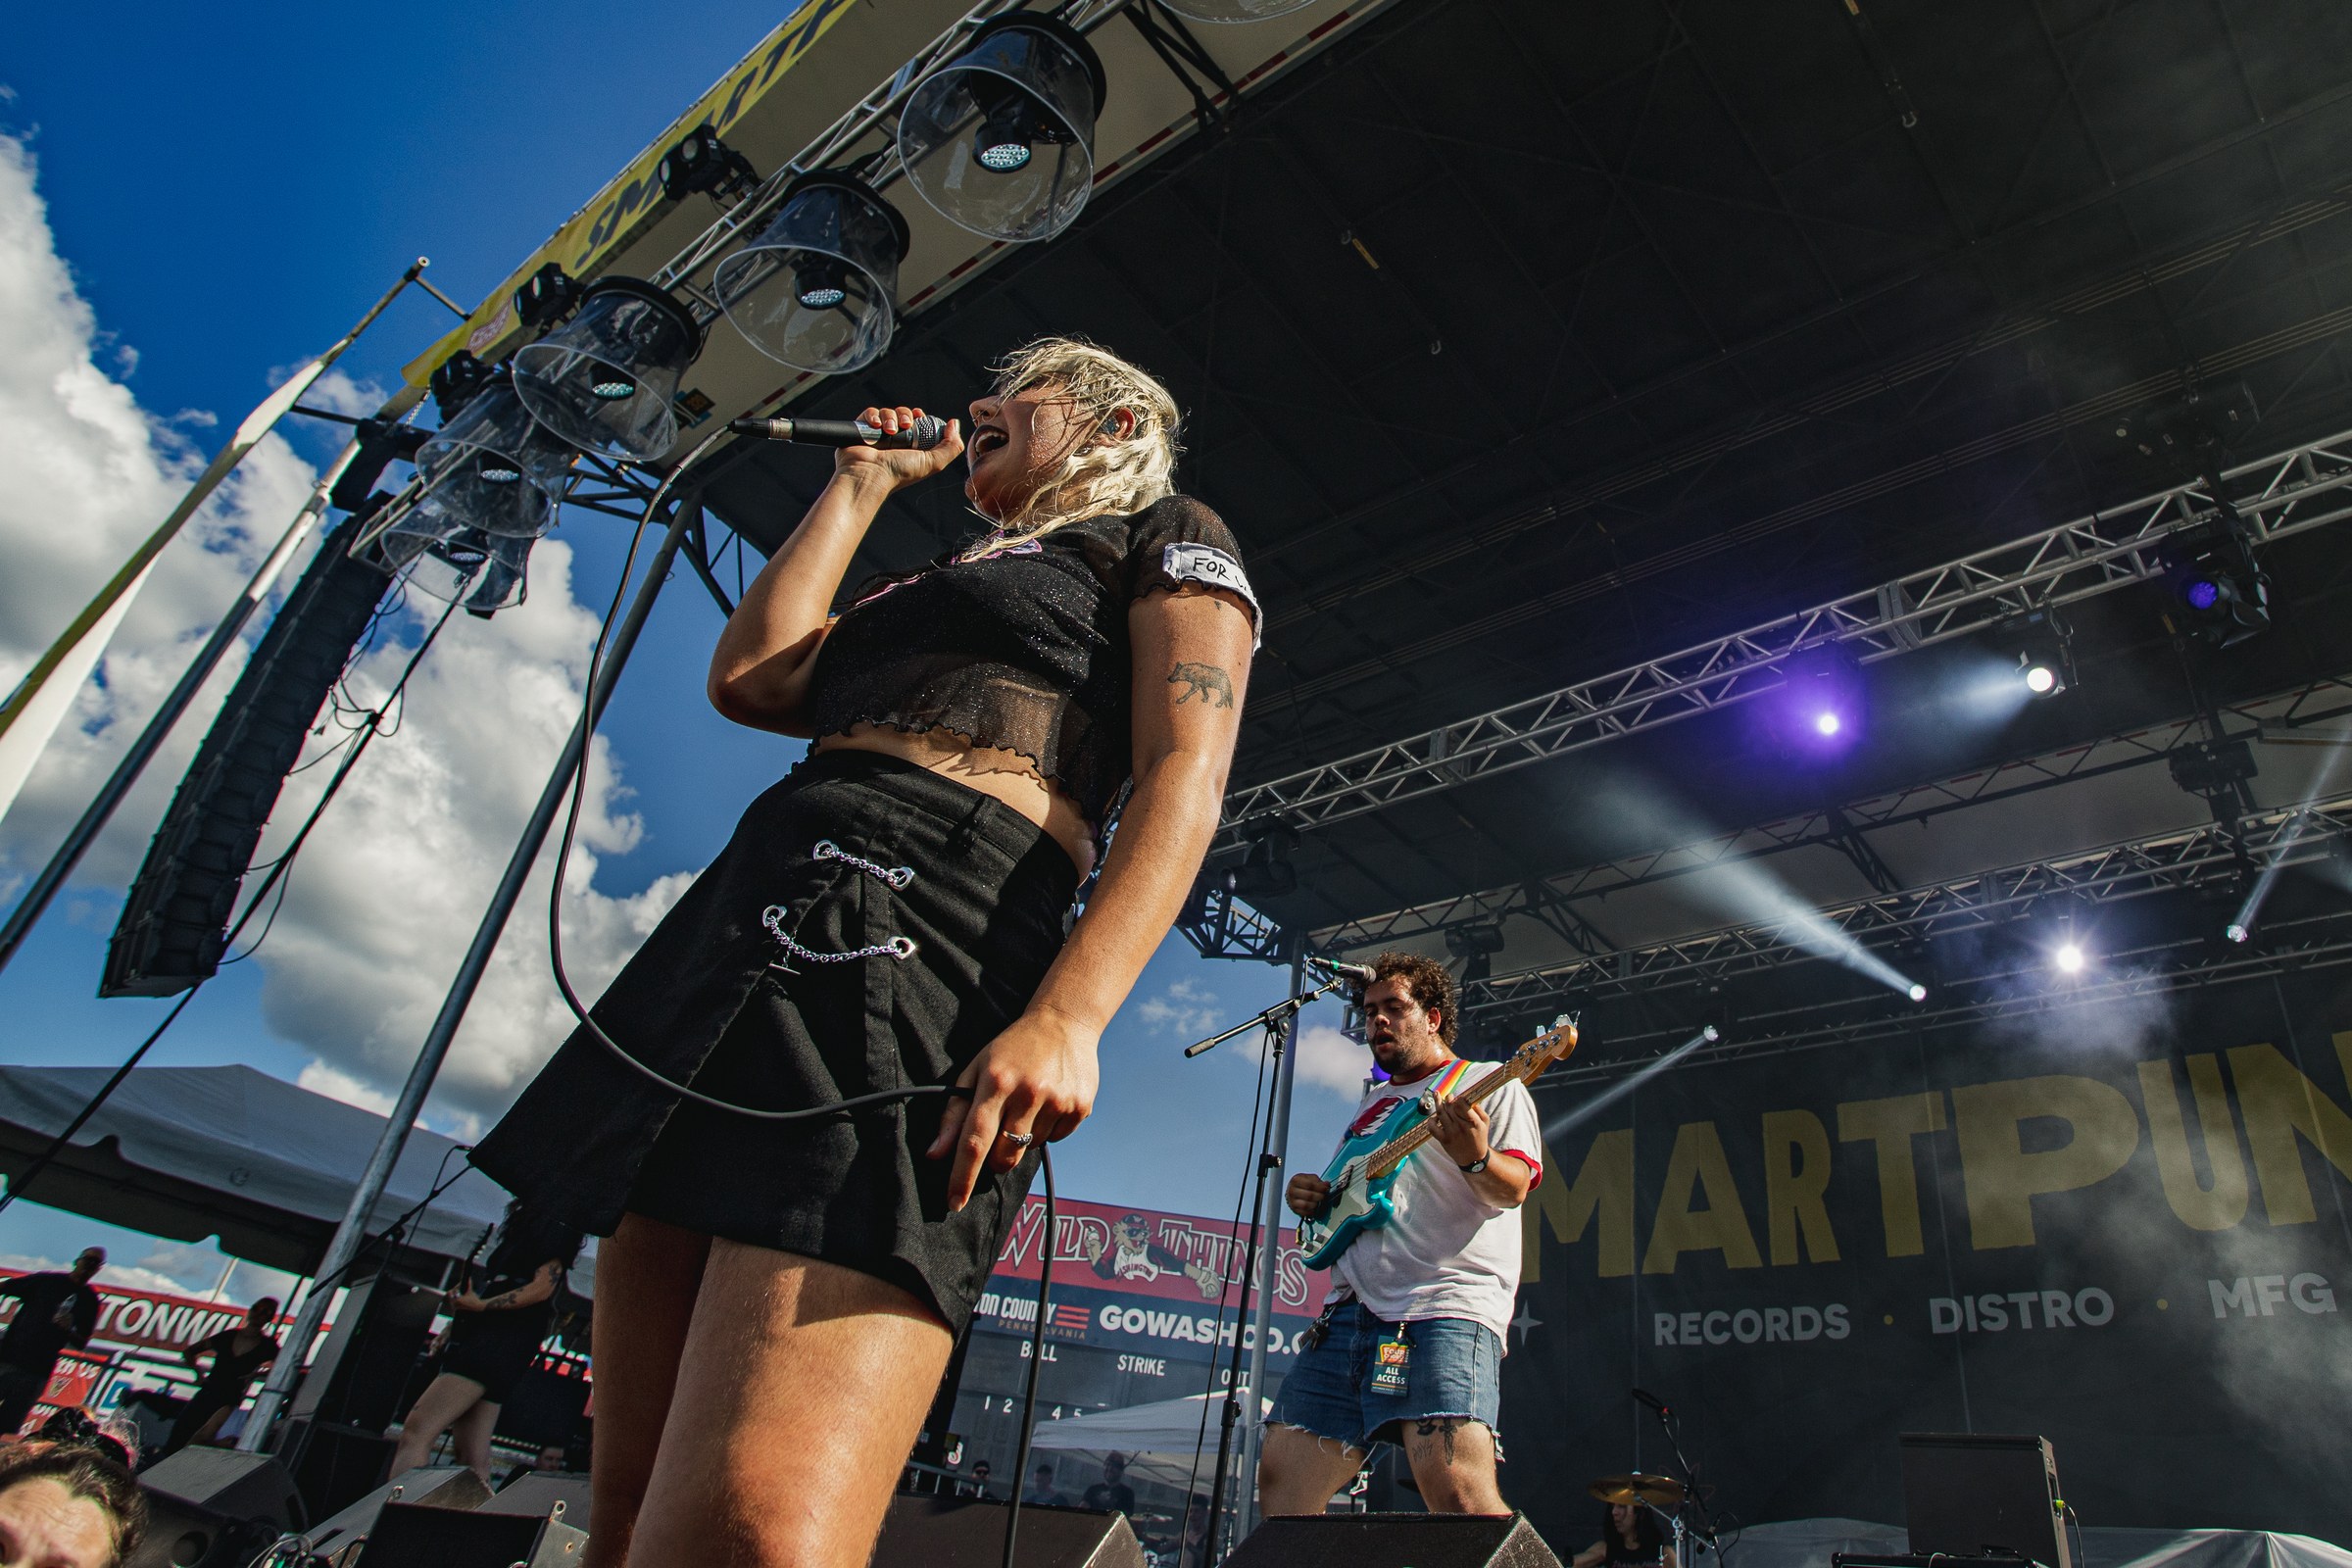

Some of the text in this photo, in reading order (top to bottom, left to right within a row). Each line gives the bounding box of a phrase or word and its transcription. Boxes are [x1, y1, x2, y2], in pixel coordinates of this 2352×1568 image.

[1193, 558, 1230, 580] FOR
[1001, 1297, 1057, 1325] COUNY
[1654, 1273, 2337, 1347] RECORDS DISTRO MFG
[998, 1319, 1087, 1341] PENNSLVANIA
[1020, 1340, 1058, 1362] BLL
[1117, 1354, 1166, 1377] STRIKE
[1376, 1374, 1405, 1384] ACCESS
[1003, 1397, 1014, 1414] 2
[1052, 1405, 1062, 1421] 4
